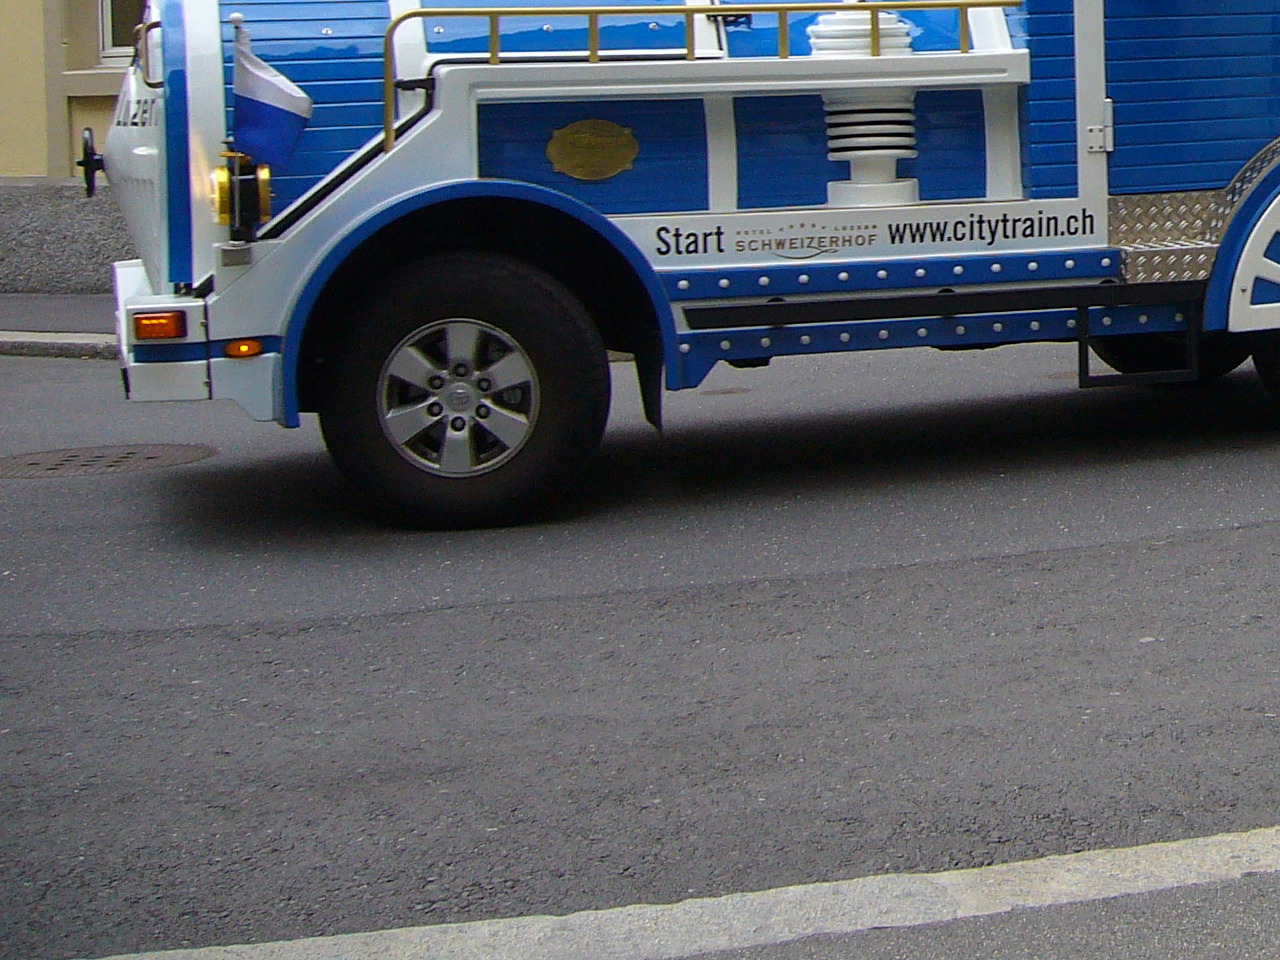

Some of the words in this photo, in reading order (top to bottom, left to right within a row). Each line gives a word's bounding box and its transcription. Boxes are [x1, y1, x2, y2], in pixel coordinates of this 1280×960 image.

[655, 225, 725, 256] Start
[888, 207, 1095, 246] www.citytrain.ch
[735, 234, 878, 253] SCHWEIZERHOF
